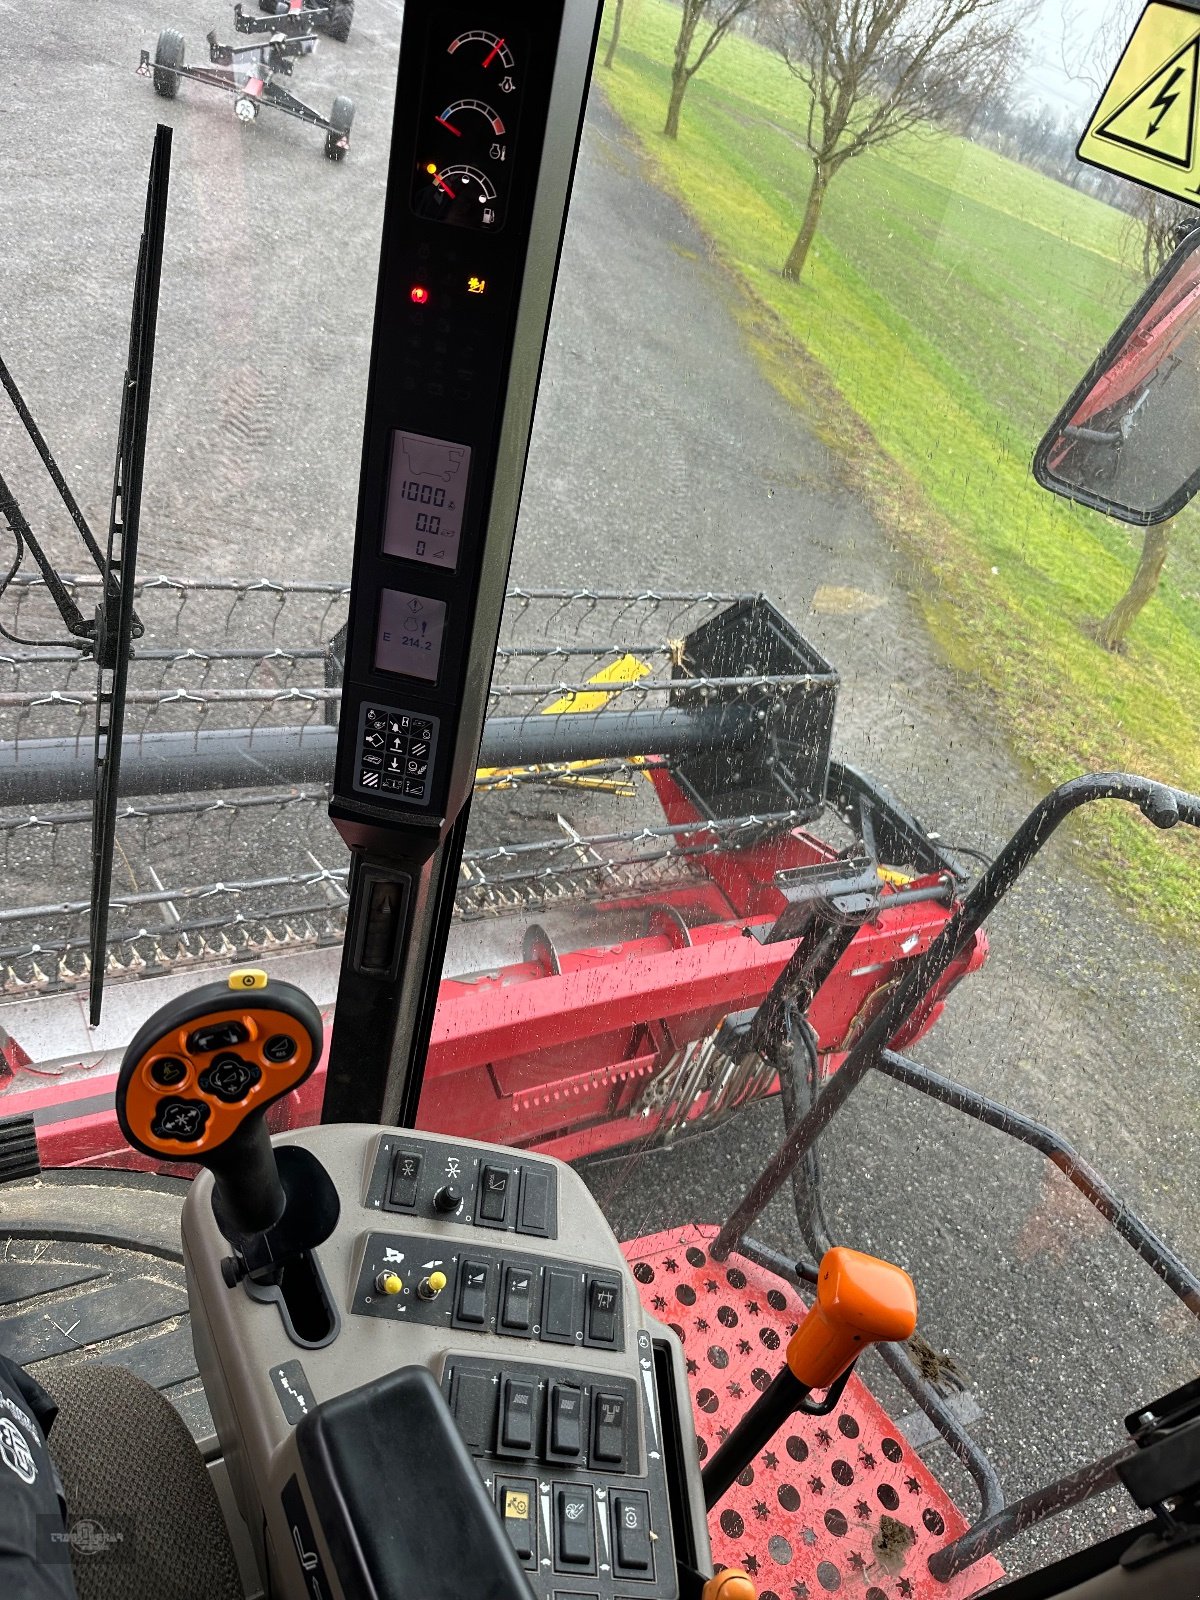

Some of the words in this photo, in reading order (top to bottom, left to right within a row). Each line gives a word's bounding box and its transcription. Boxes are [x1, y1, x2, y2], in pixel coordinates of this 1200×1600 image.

[401, 480, 446, 507] 1000
[415, 512, 441, 535] 0.0
[382, 631, 392, 642] E
[401, 635, 433, 651] 214.2
